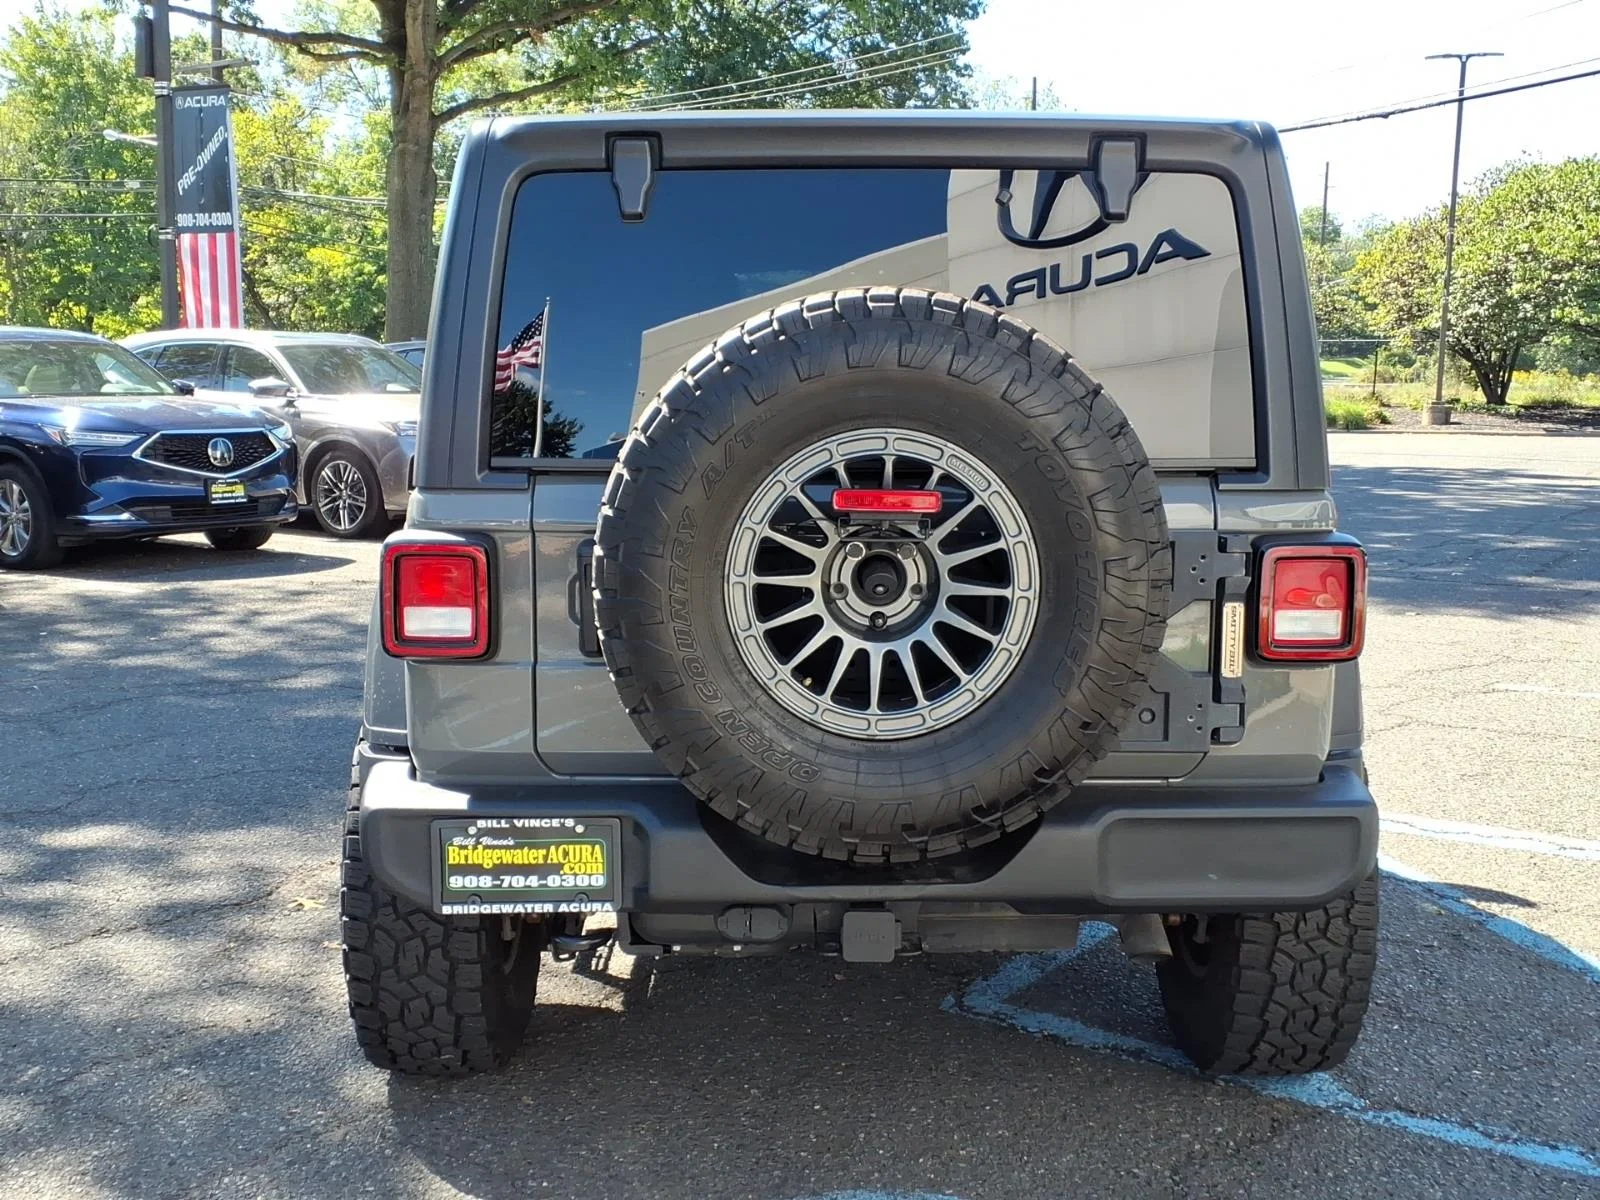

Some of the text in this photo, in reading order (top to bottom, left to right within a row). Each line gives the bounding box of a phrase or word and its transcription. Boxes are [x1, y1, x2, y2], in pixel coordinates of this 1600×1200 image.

[184, 95, 226, 108] ACURA
[177, 126, 226, 196] PRE-OWNED
[177, 211, 233, 228] 908-704-0300
[701, 420, 758, 501] A/T
[1015, 429, 1094, 542] TOYO
[668, 504, 723, 705] COUNTRY
[1229, 605, 1238, 676] SMITTYBILT
[714, 708, 822, 783] OPEN
[476, 818, 576, 829] BILL VINCE'S
[447, 844, 604, 870] Bridgewater ACURA
[559, 861, 604, 875] .com
[448, 874, 605, 889] 908-704-0300
[441, 902, 614, 915] BRIDGEWATER ACURA
